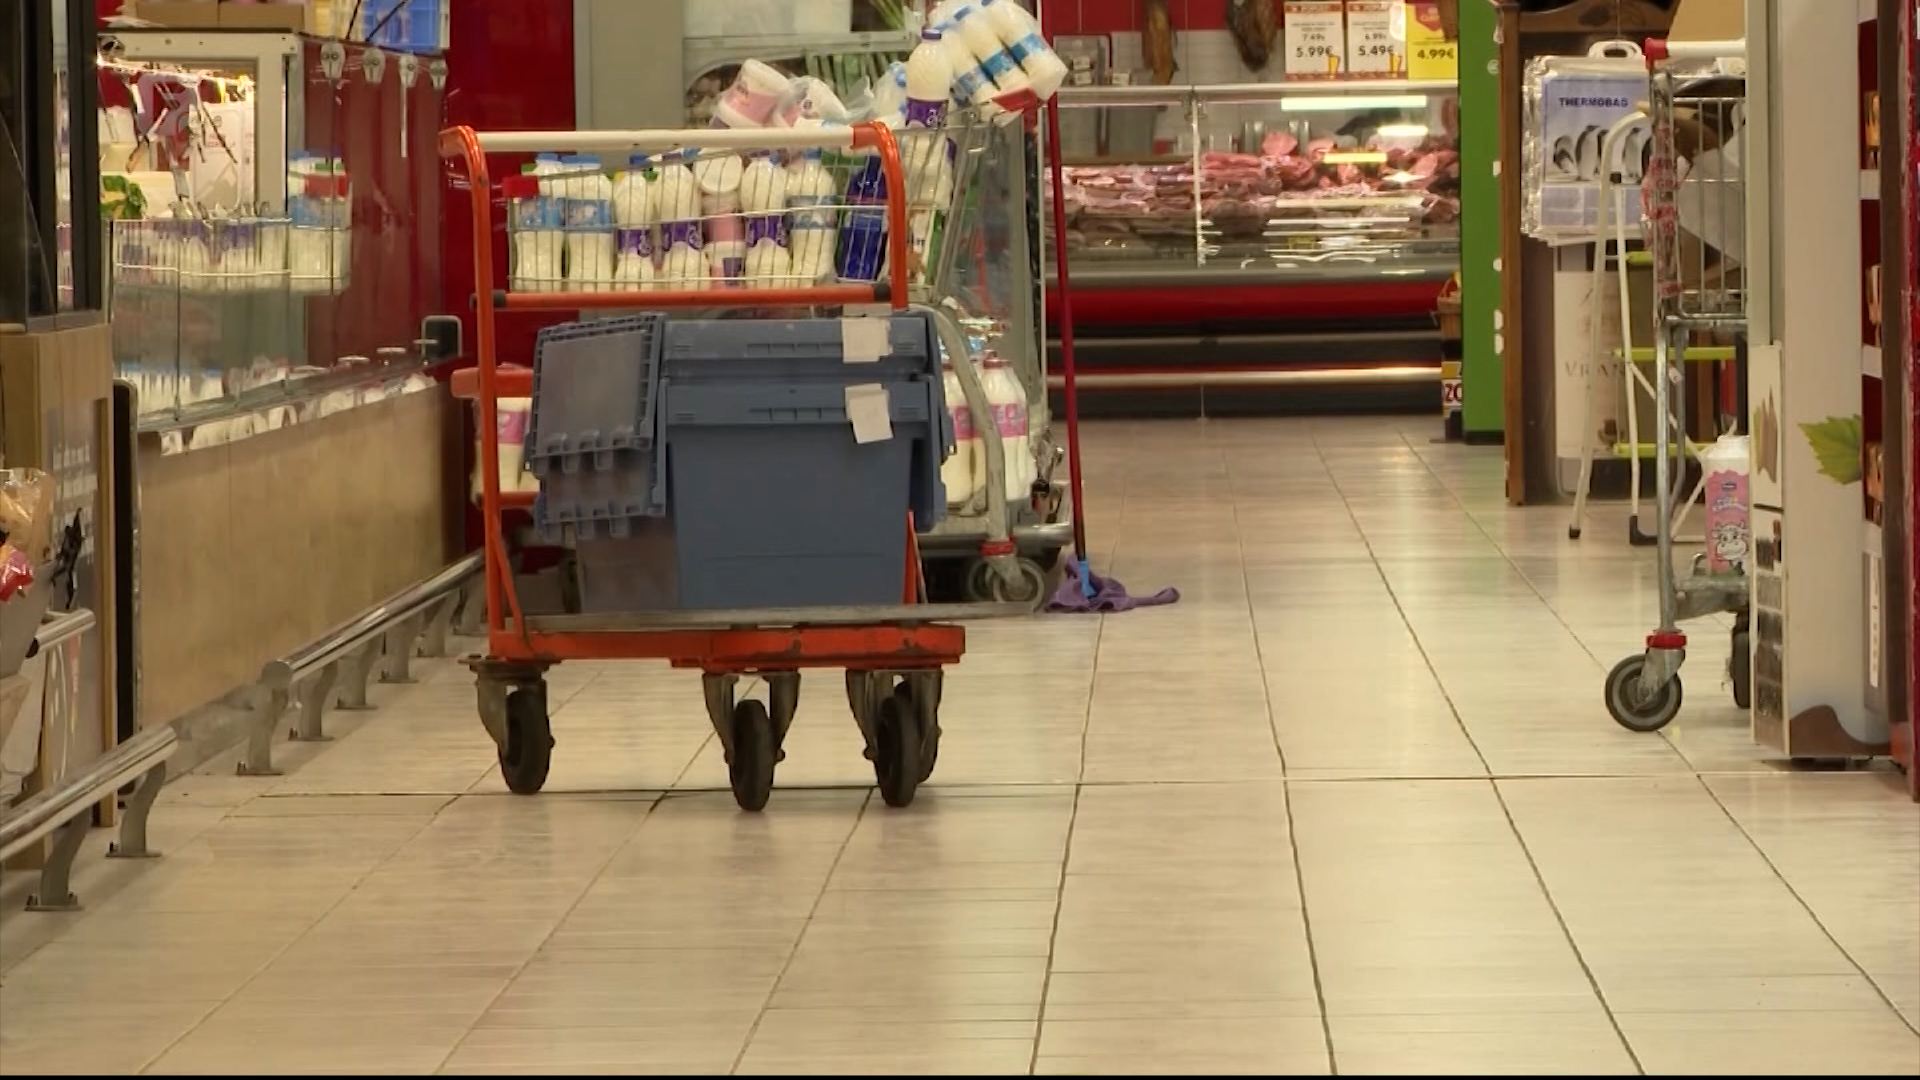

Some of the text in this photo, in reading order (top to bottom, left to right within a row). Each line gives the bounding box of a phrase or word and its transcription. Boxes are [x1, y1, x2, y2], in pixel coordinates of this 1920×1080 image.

[1296, 45, 1333, 58] 5.99€
[1358, 45, 1394, 57] 5.49€
[1417, 47, 1454, 60] 4.99€
[1557, 97, 1629, 108] THERMOBAG
